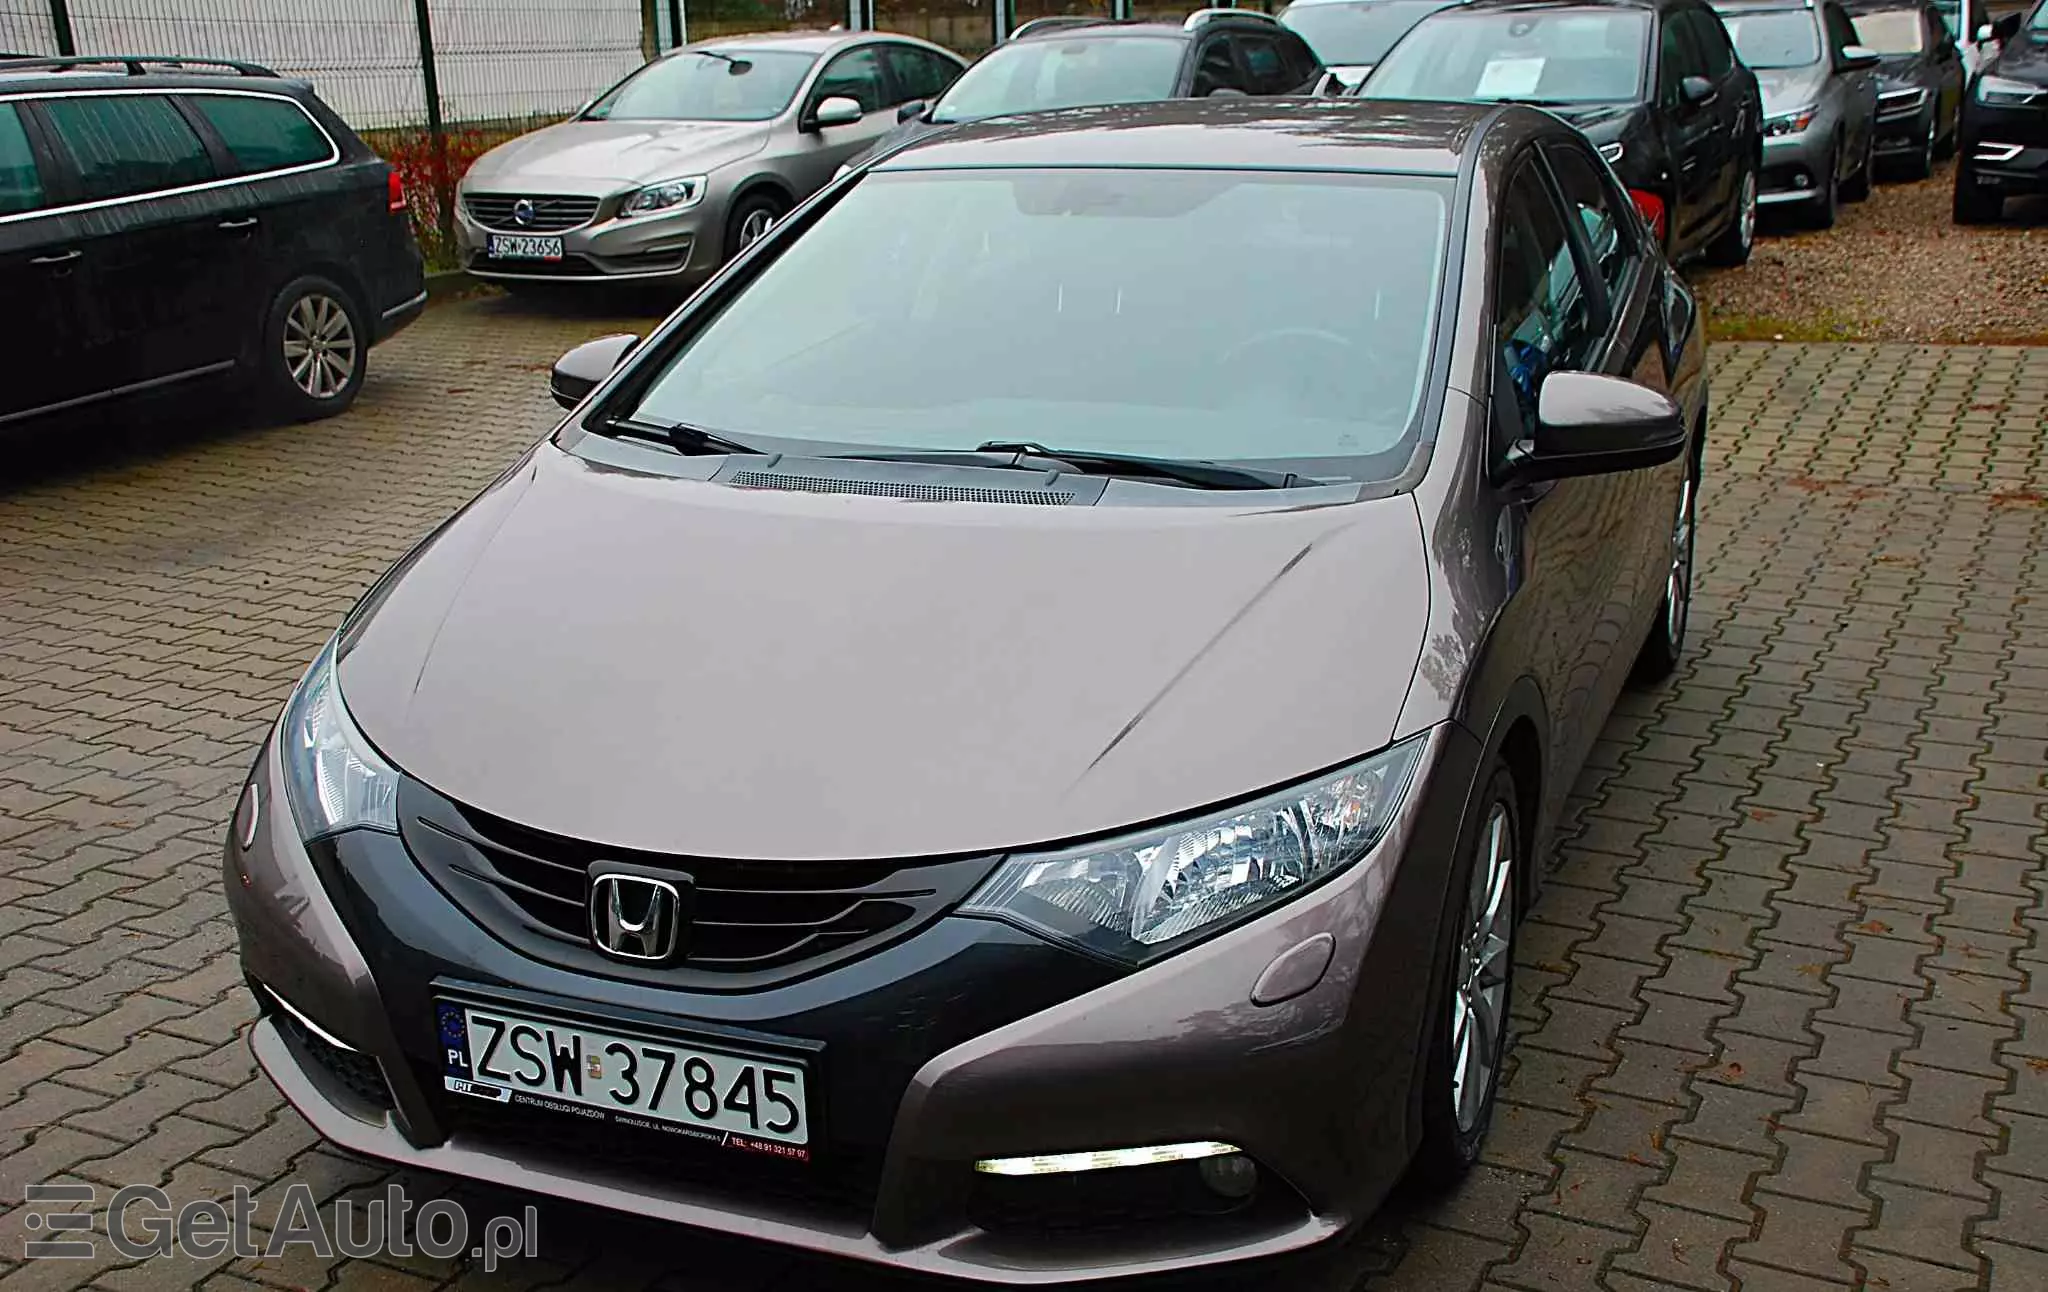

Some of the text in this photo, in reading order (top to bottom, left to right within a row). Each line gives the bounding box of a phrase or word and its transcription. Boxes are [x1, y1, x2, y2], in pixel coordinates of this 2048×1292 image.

[495, 237, 561, 256] ZSW 23656
[447, 1048, 469, 1068] PL
[470, 1014, 801, 1135] ZSW 37845
